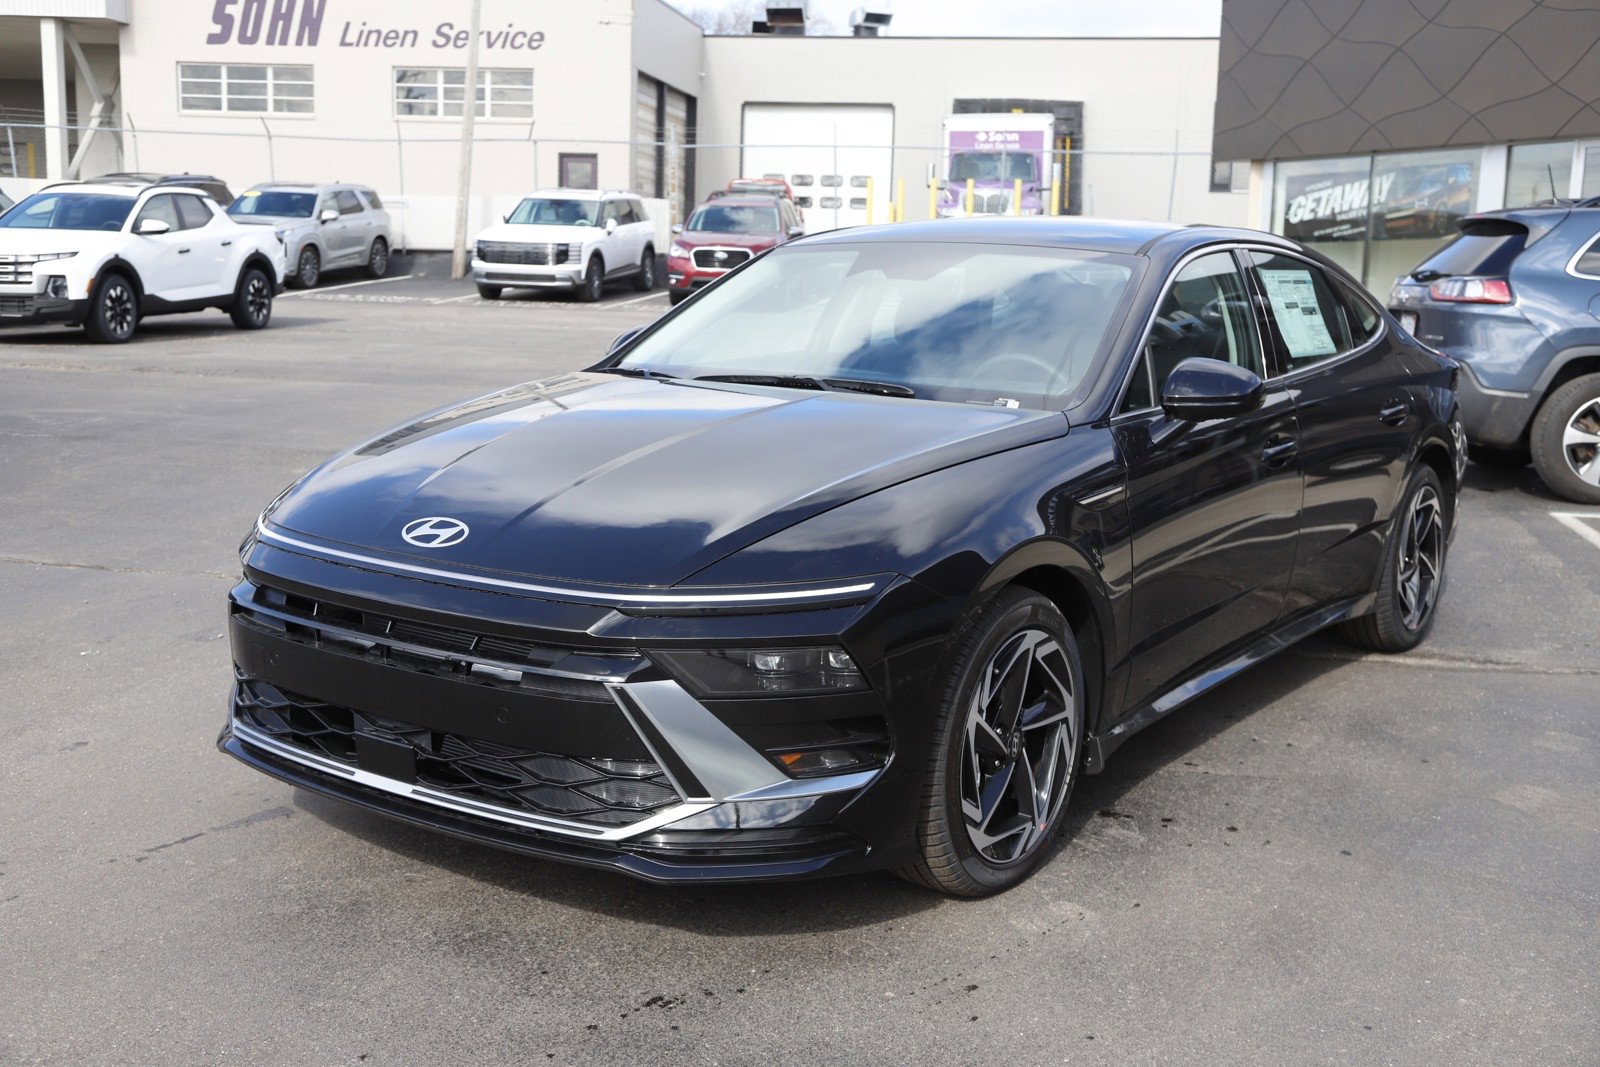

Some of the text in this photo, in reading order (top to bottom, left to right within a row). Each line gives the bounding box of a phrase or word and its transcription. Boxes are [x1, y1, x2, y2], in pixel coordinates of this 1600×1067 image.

[206, 0, 327, 47] SOHN
[339, 21, 419, 48] Linen
[1286, 172, 1397, 224] GETAWAY
